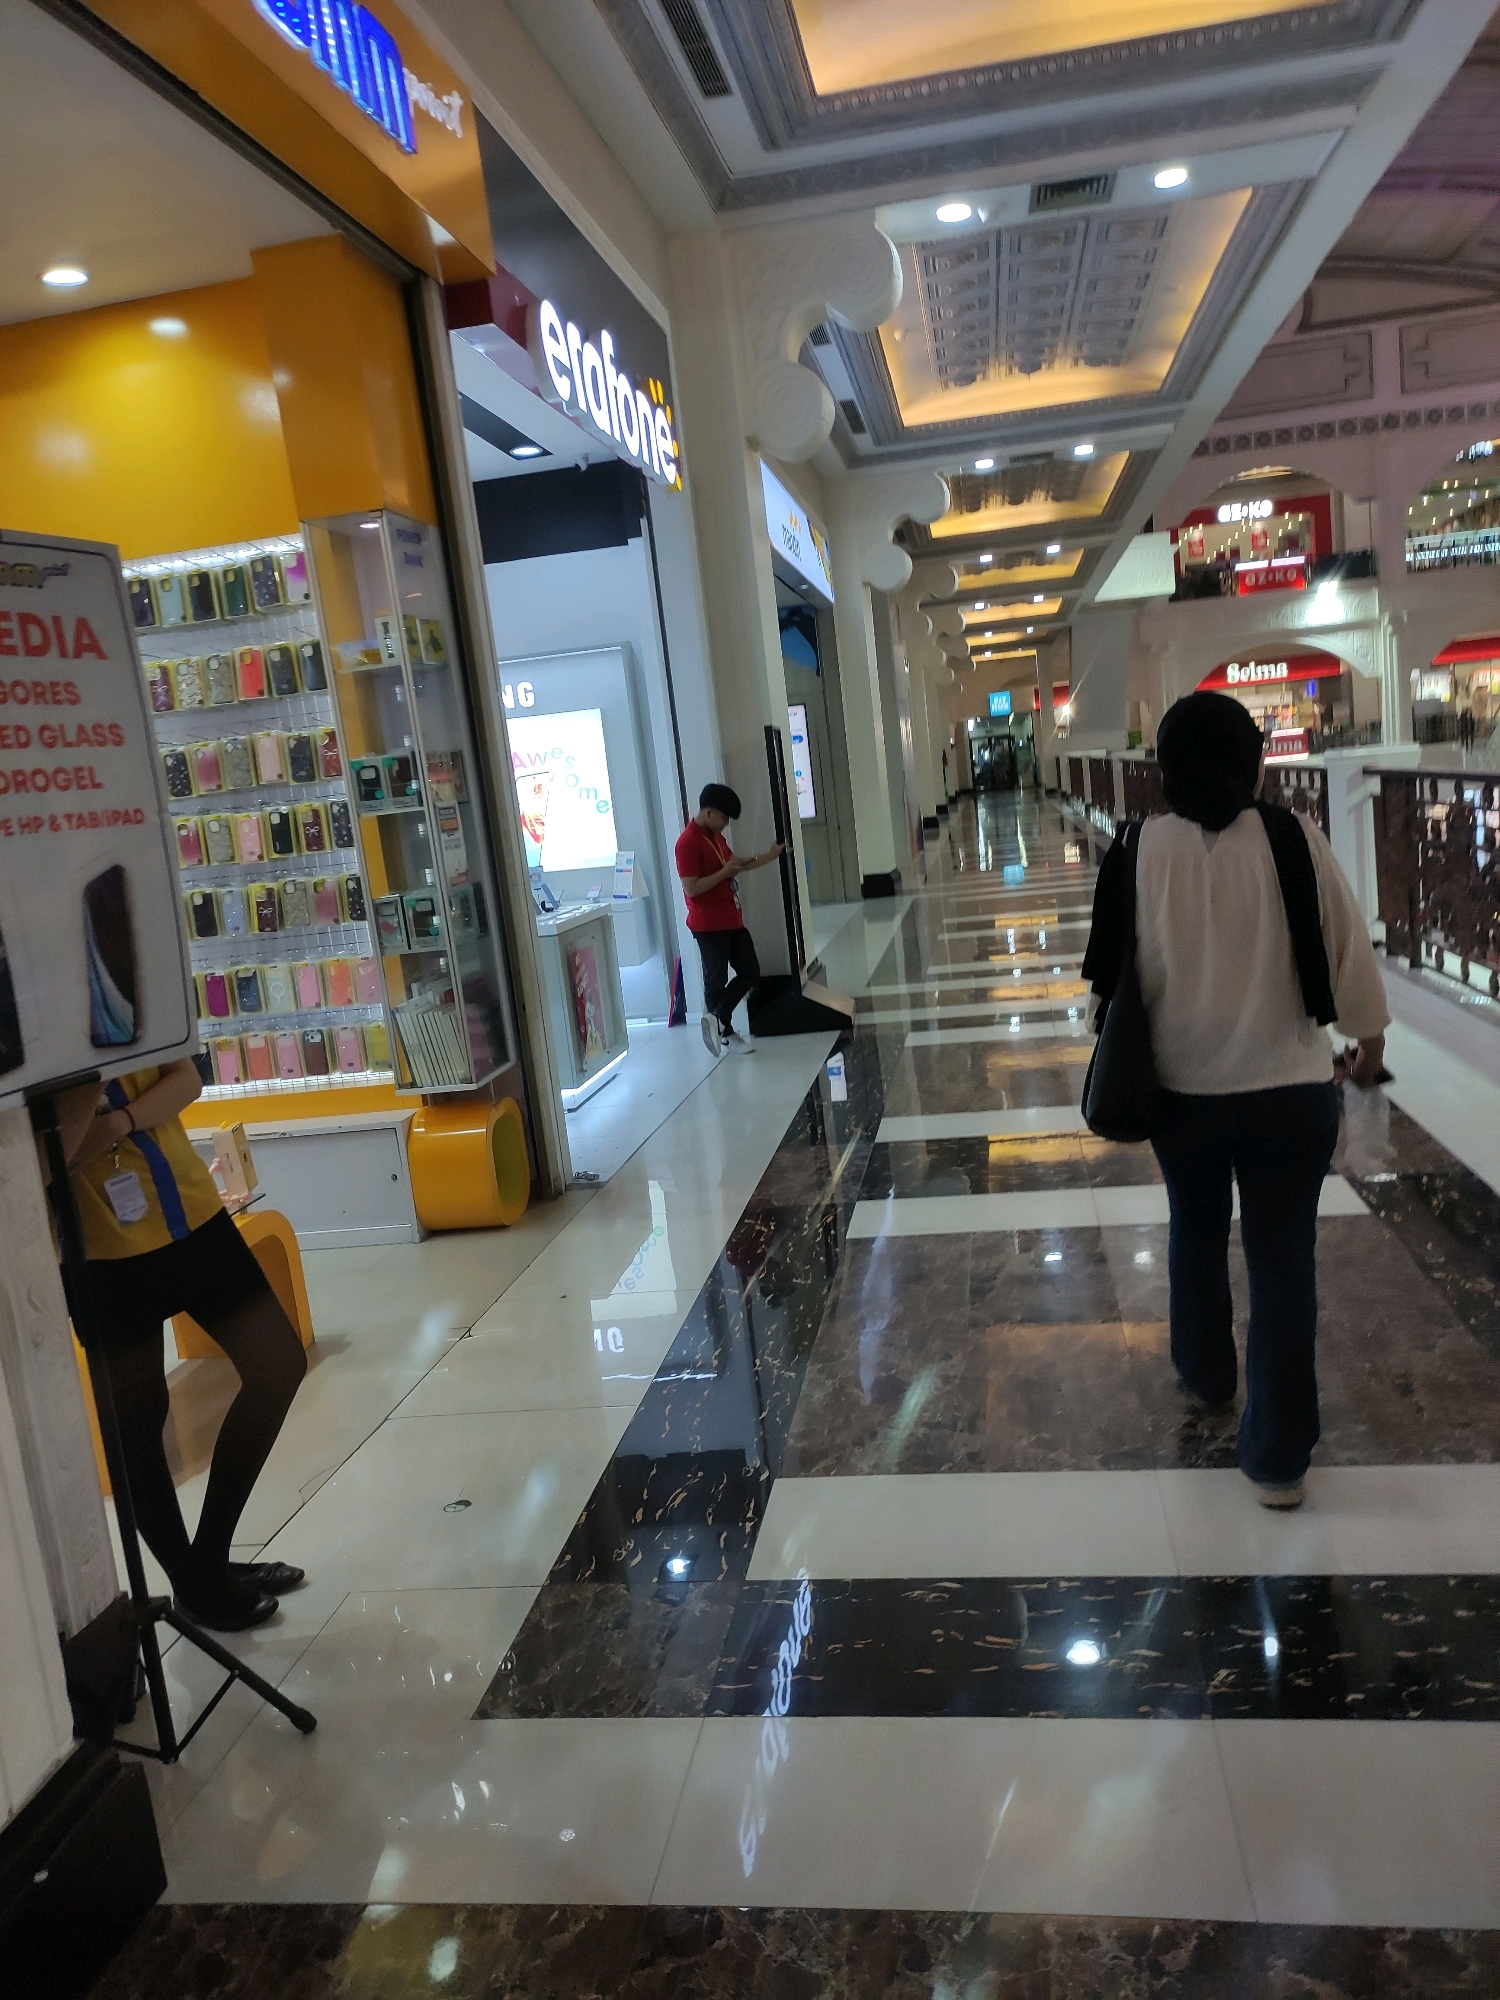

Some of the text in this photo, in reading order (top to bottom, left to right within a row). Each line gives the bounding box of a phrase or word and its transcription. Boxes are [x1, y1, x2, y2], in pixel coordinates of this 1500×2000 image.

[539, 299, 677, 487] erafone
[37, 722, 126, 749] GLASS
[512, 746, 610, 815] Awesome
